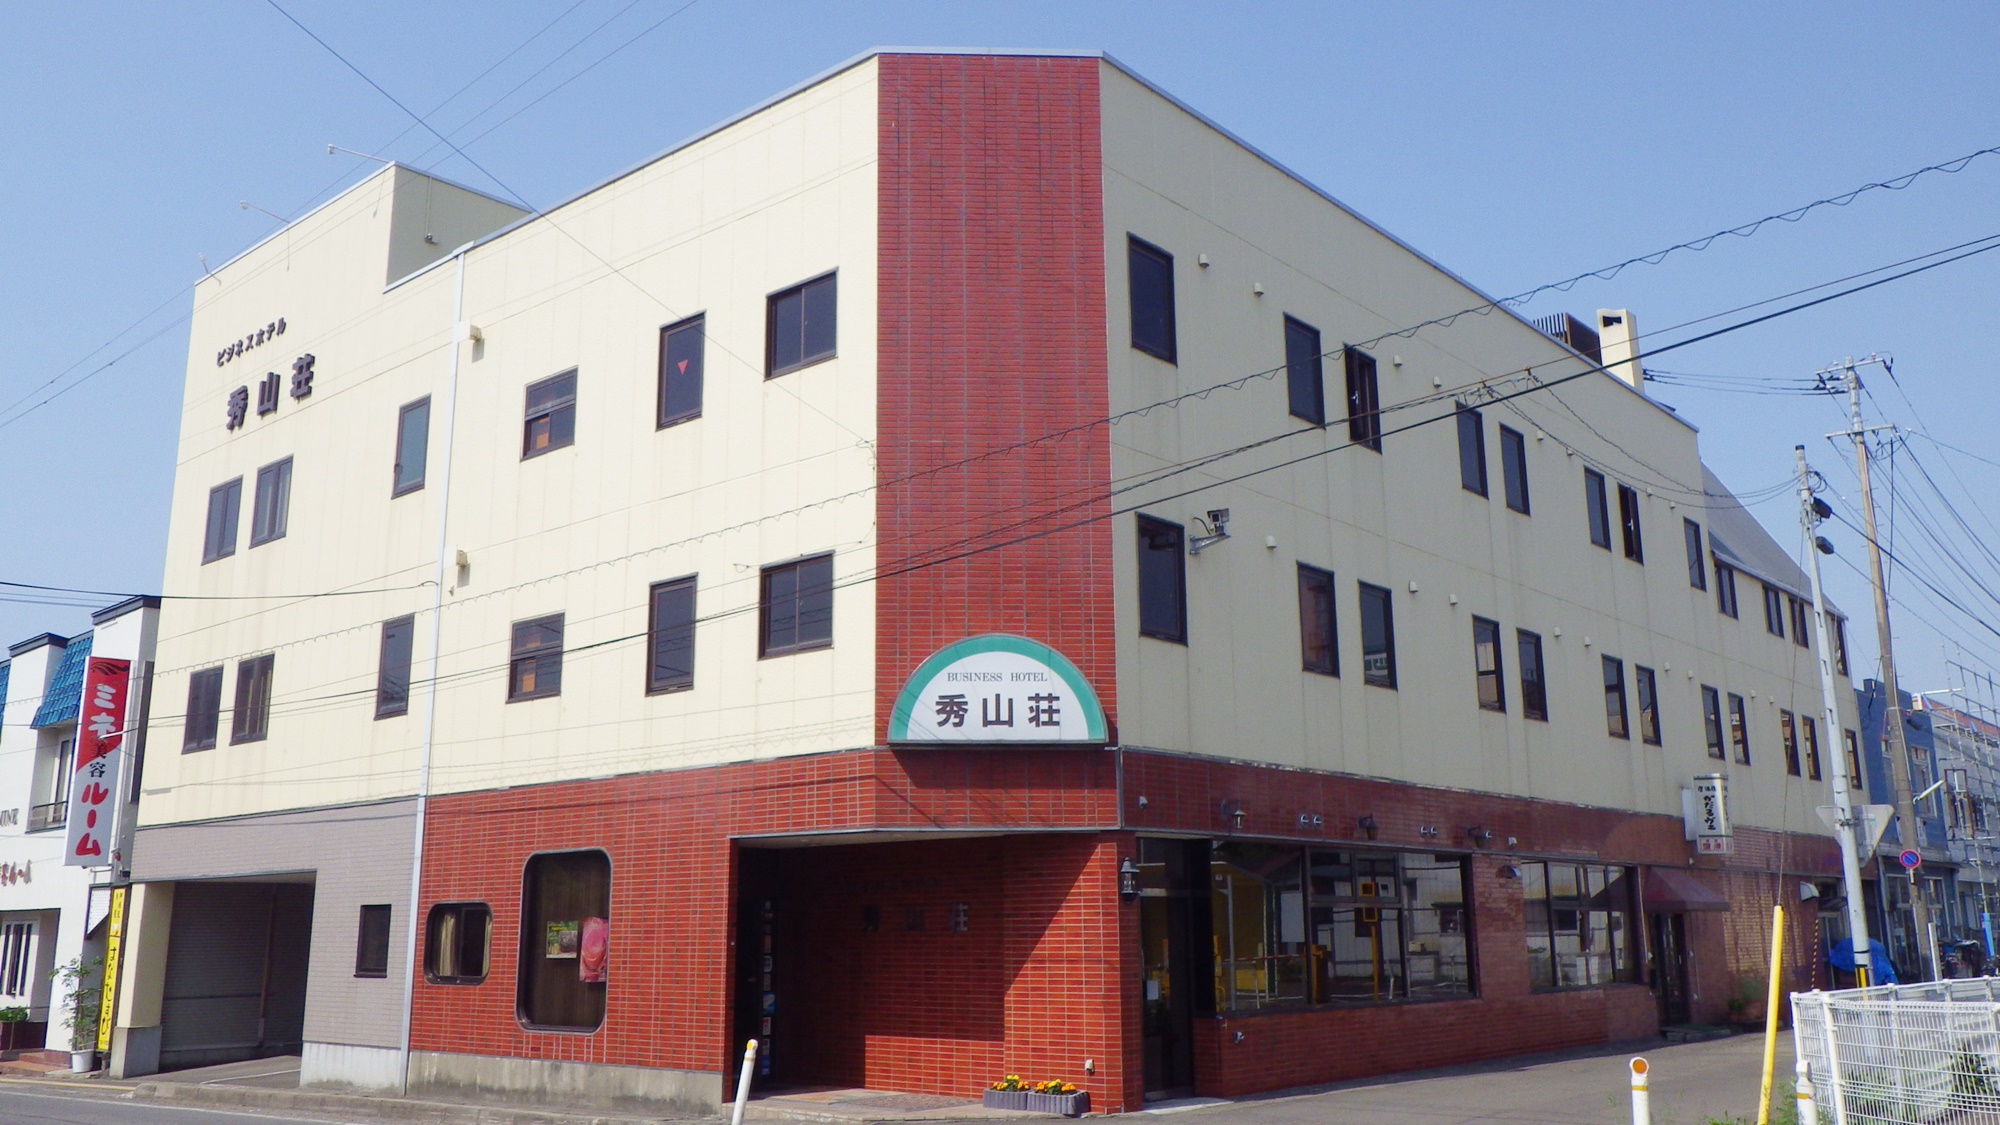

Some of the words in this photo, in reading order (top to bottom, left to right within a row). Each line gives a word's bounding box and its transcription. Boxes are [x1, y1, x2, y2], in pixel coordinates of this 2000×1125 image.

[216, 317, 287, 368] ビジネスホテル
[226, 353, 316, 432] 秀山荘
[947, 672, 1003, 682] BUSINESS
[1010, 672, 1048, 682] HOTEL
[935, 693, 1060, 728] 秀山荘
